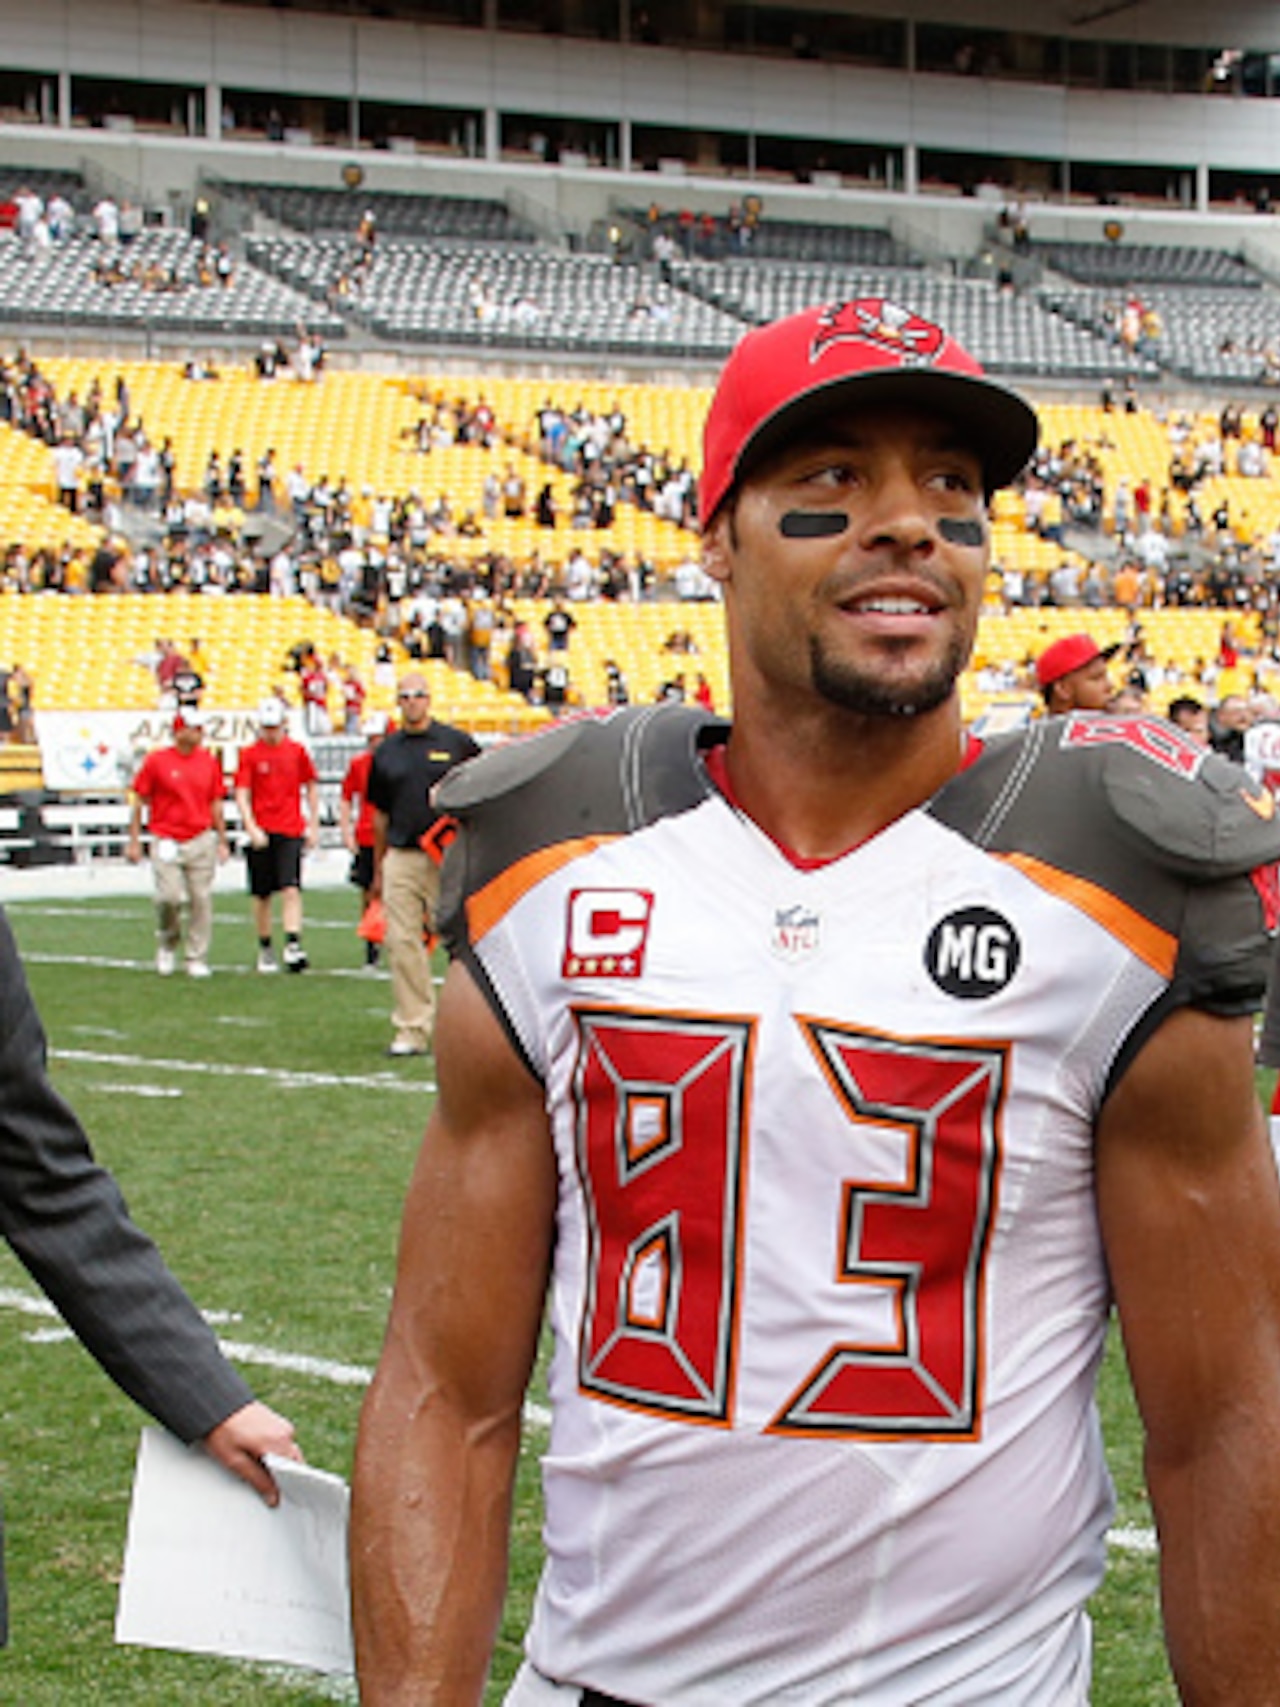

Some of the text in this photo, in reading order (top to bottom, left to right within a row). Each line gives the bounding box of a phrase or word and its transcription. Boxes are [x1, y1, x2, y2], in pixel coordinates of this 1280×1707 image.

[569, 890, 649, 956] C
[937, 923, 1010, 981] MG
[569, 1003, 1014, 1444] 83
